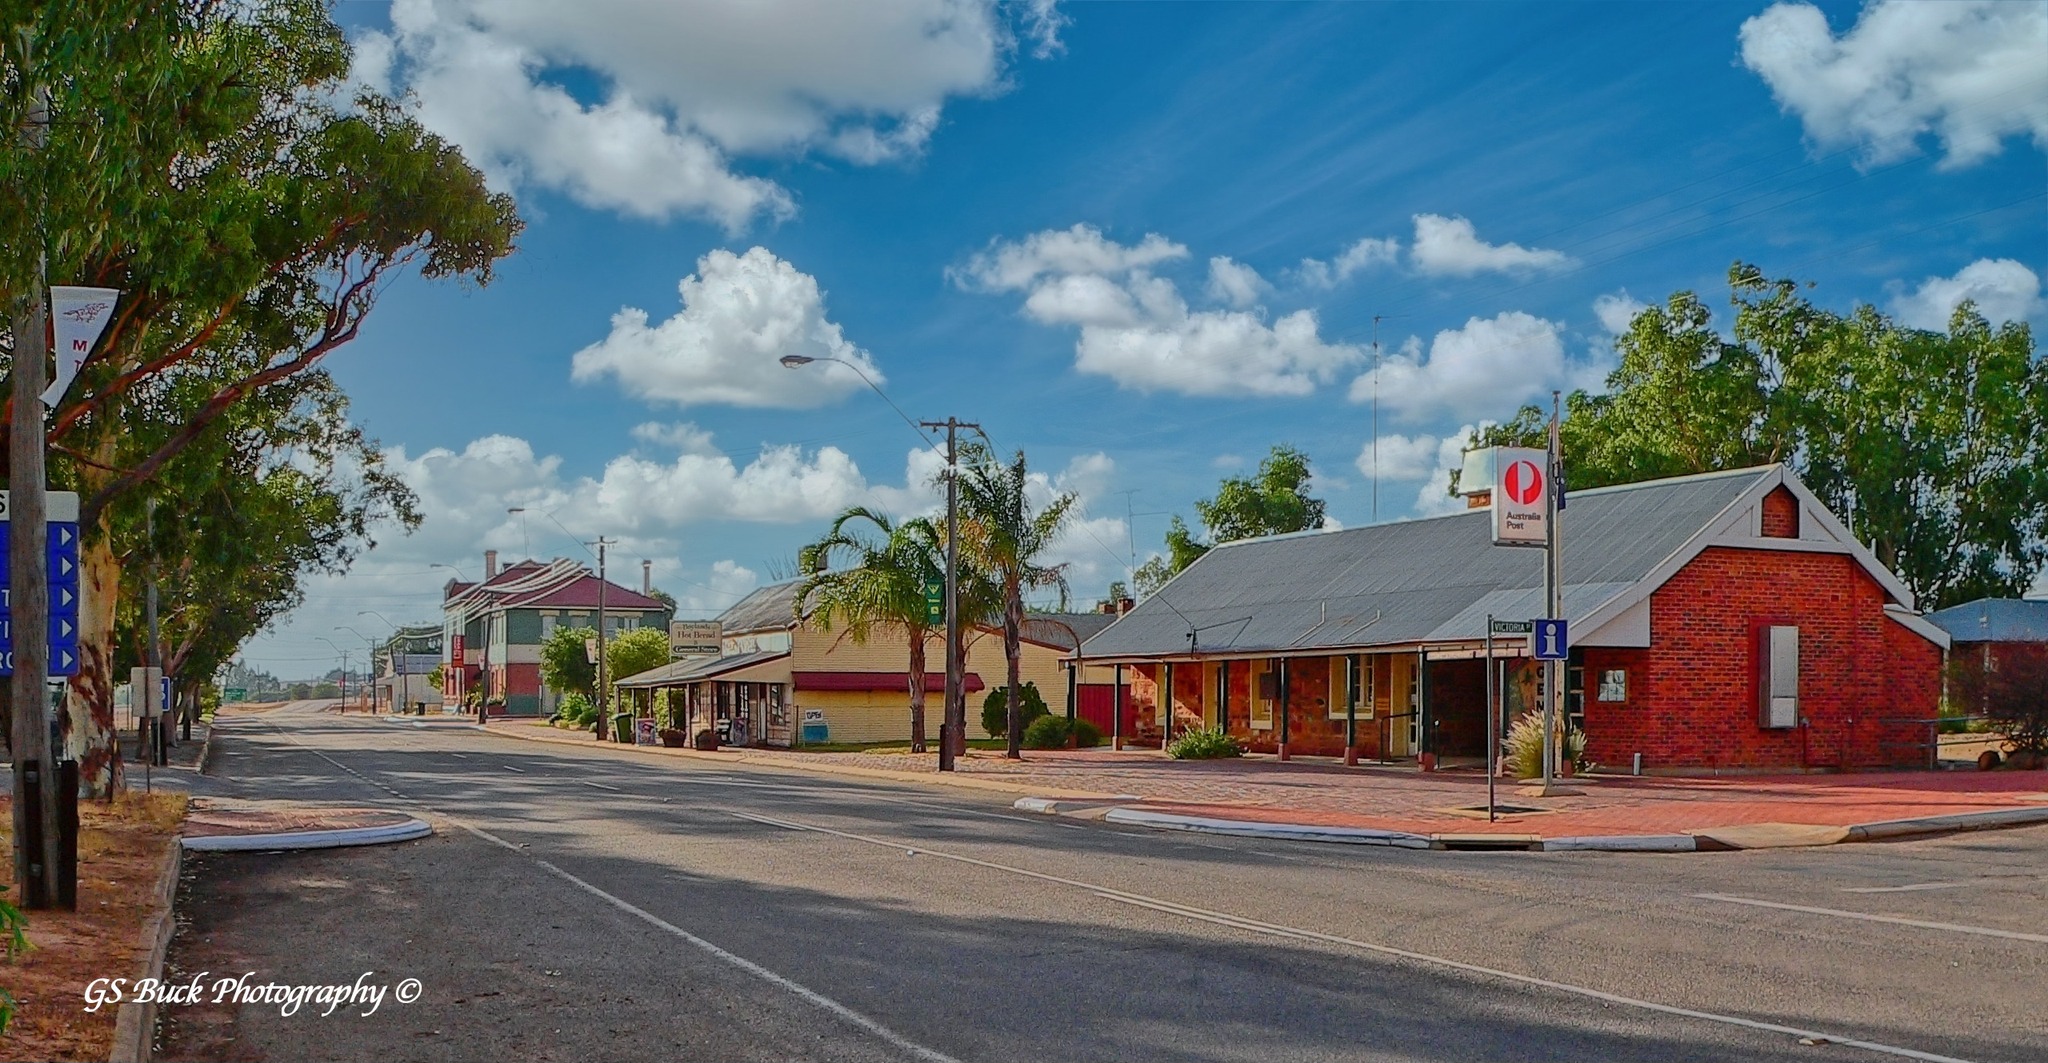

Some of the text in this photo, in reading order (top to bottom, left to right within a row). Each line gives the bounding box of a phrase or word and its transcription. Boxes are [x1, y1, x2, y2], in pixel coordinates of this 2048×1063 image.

[1506, 511, 1541, 520] Australia
[1506, 521, 1524, 530] Post
[1494, 623, 1525, 632] VICTORIA
[678, 631, 716, 639] Hot Bread
